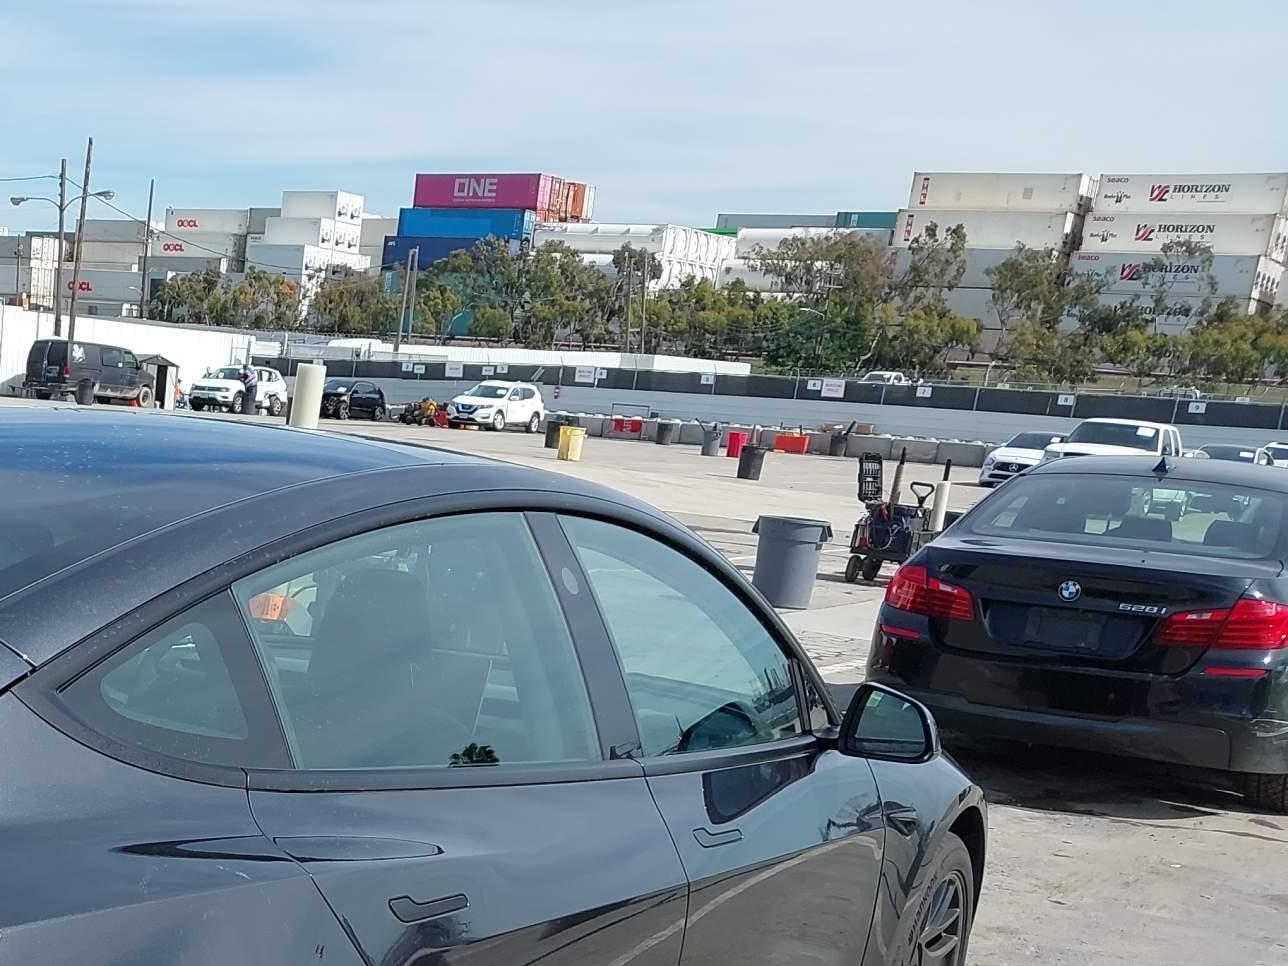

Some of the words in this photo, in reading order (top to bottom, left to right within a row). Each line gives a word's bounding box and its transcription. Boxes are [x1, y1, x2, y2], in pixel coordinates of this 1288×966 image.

[454, 177, 498, 197] ONE
[1172, 184, 1232, 194] HORIZON
[177, 219, 199, 228] OOCL
[1158, 224, 1216, 234] HORIZON
[163, 243, 185, 252] OOCL
